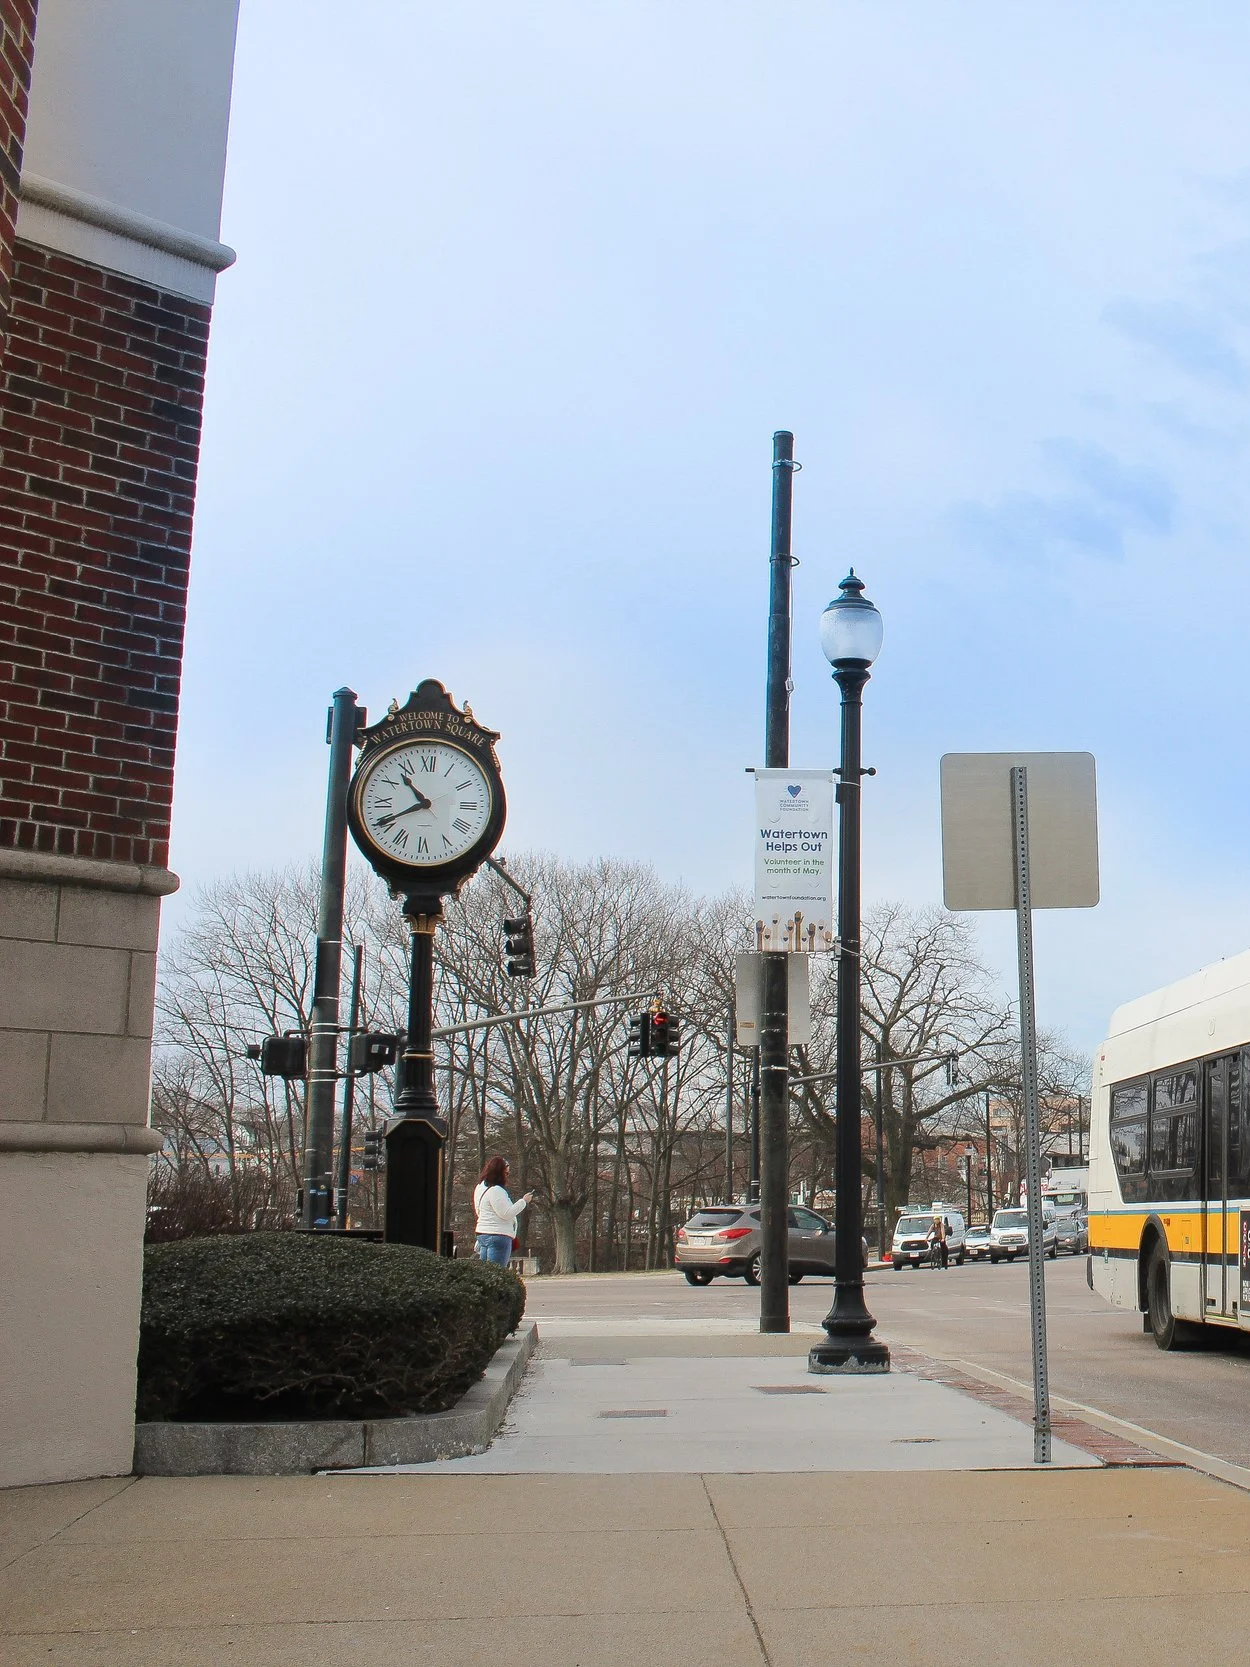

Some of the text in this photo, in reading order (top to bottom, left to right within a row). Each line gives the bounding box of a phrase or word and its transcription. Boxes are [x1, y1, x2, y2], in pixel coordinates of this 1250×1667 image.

[399, 711, 460, 724] WELCOME TO
[370, 719, 486, 747] WATERTOWN SQUARE
[760, 829, 828, 840] Watertown
[766, 841, 822, 853] Helps Out
[764, 858, 825, 866] Volunteer in the
[802, 867, 822, 876] May.
